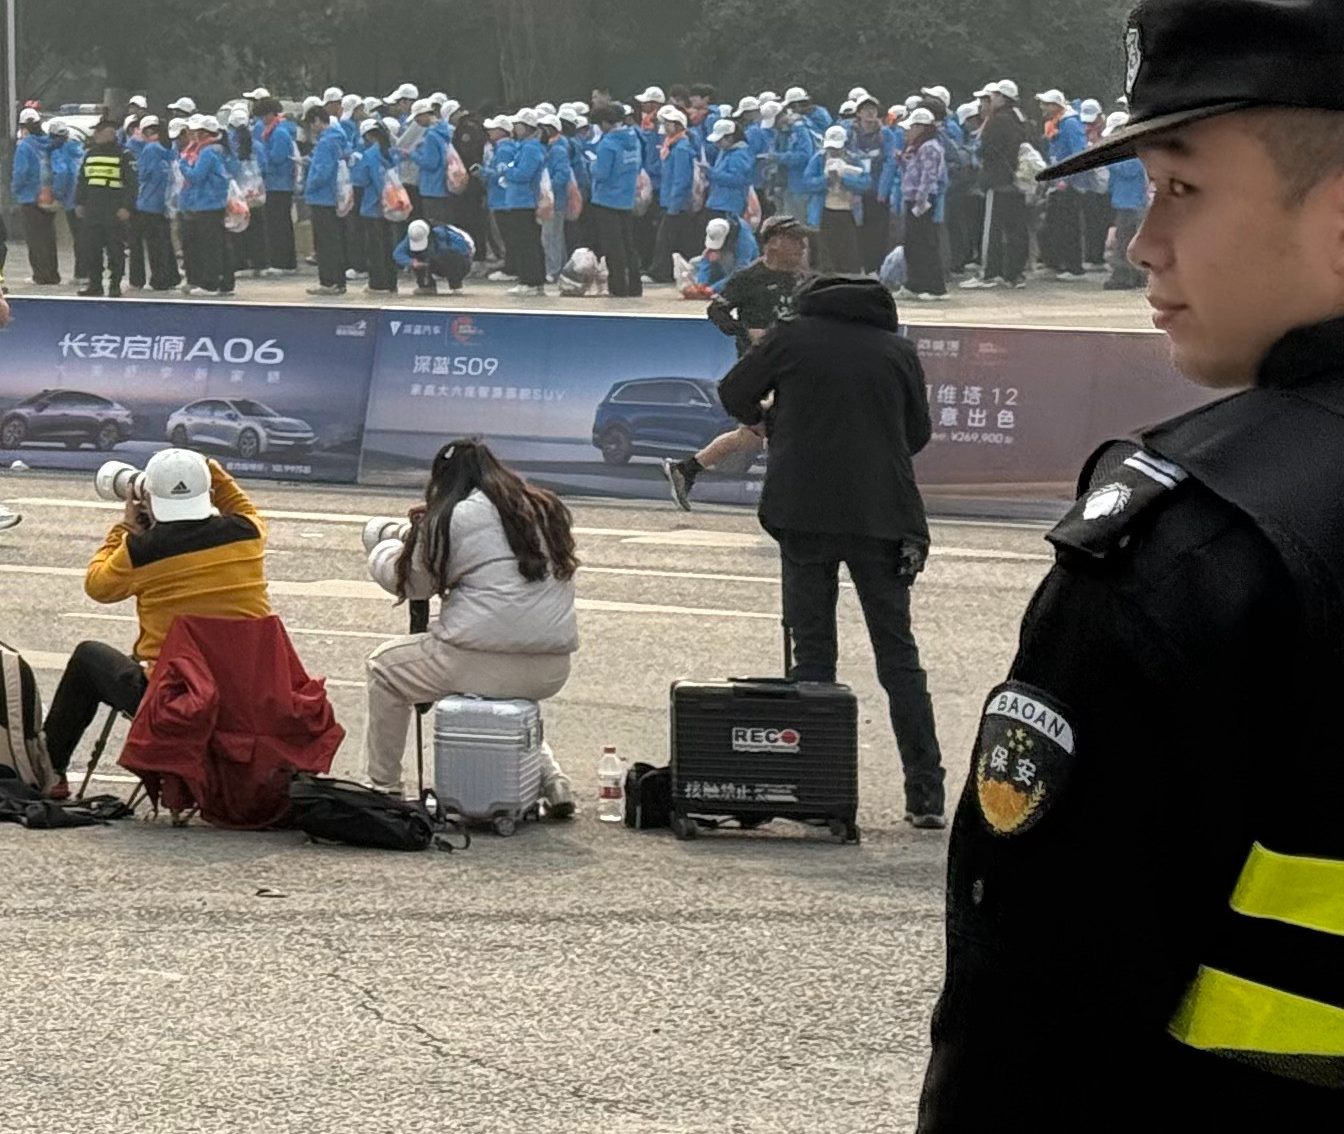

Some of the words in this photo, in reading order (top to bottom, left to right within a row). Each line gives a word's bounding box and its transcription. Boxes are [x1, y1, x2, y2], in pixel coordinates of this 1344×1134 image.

[58, 332, 285, 365] 长安启源A06
[413, 354, 499, 376] 深蓝S09
[997, 694, 1065, 738] BAOAN
[990, 744, 1036, 786] 保安
